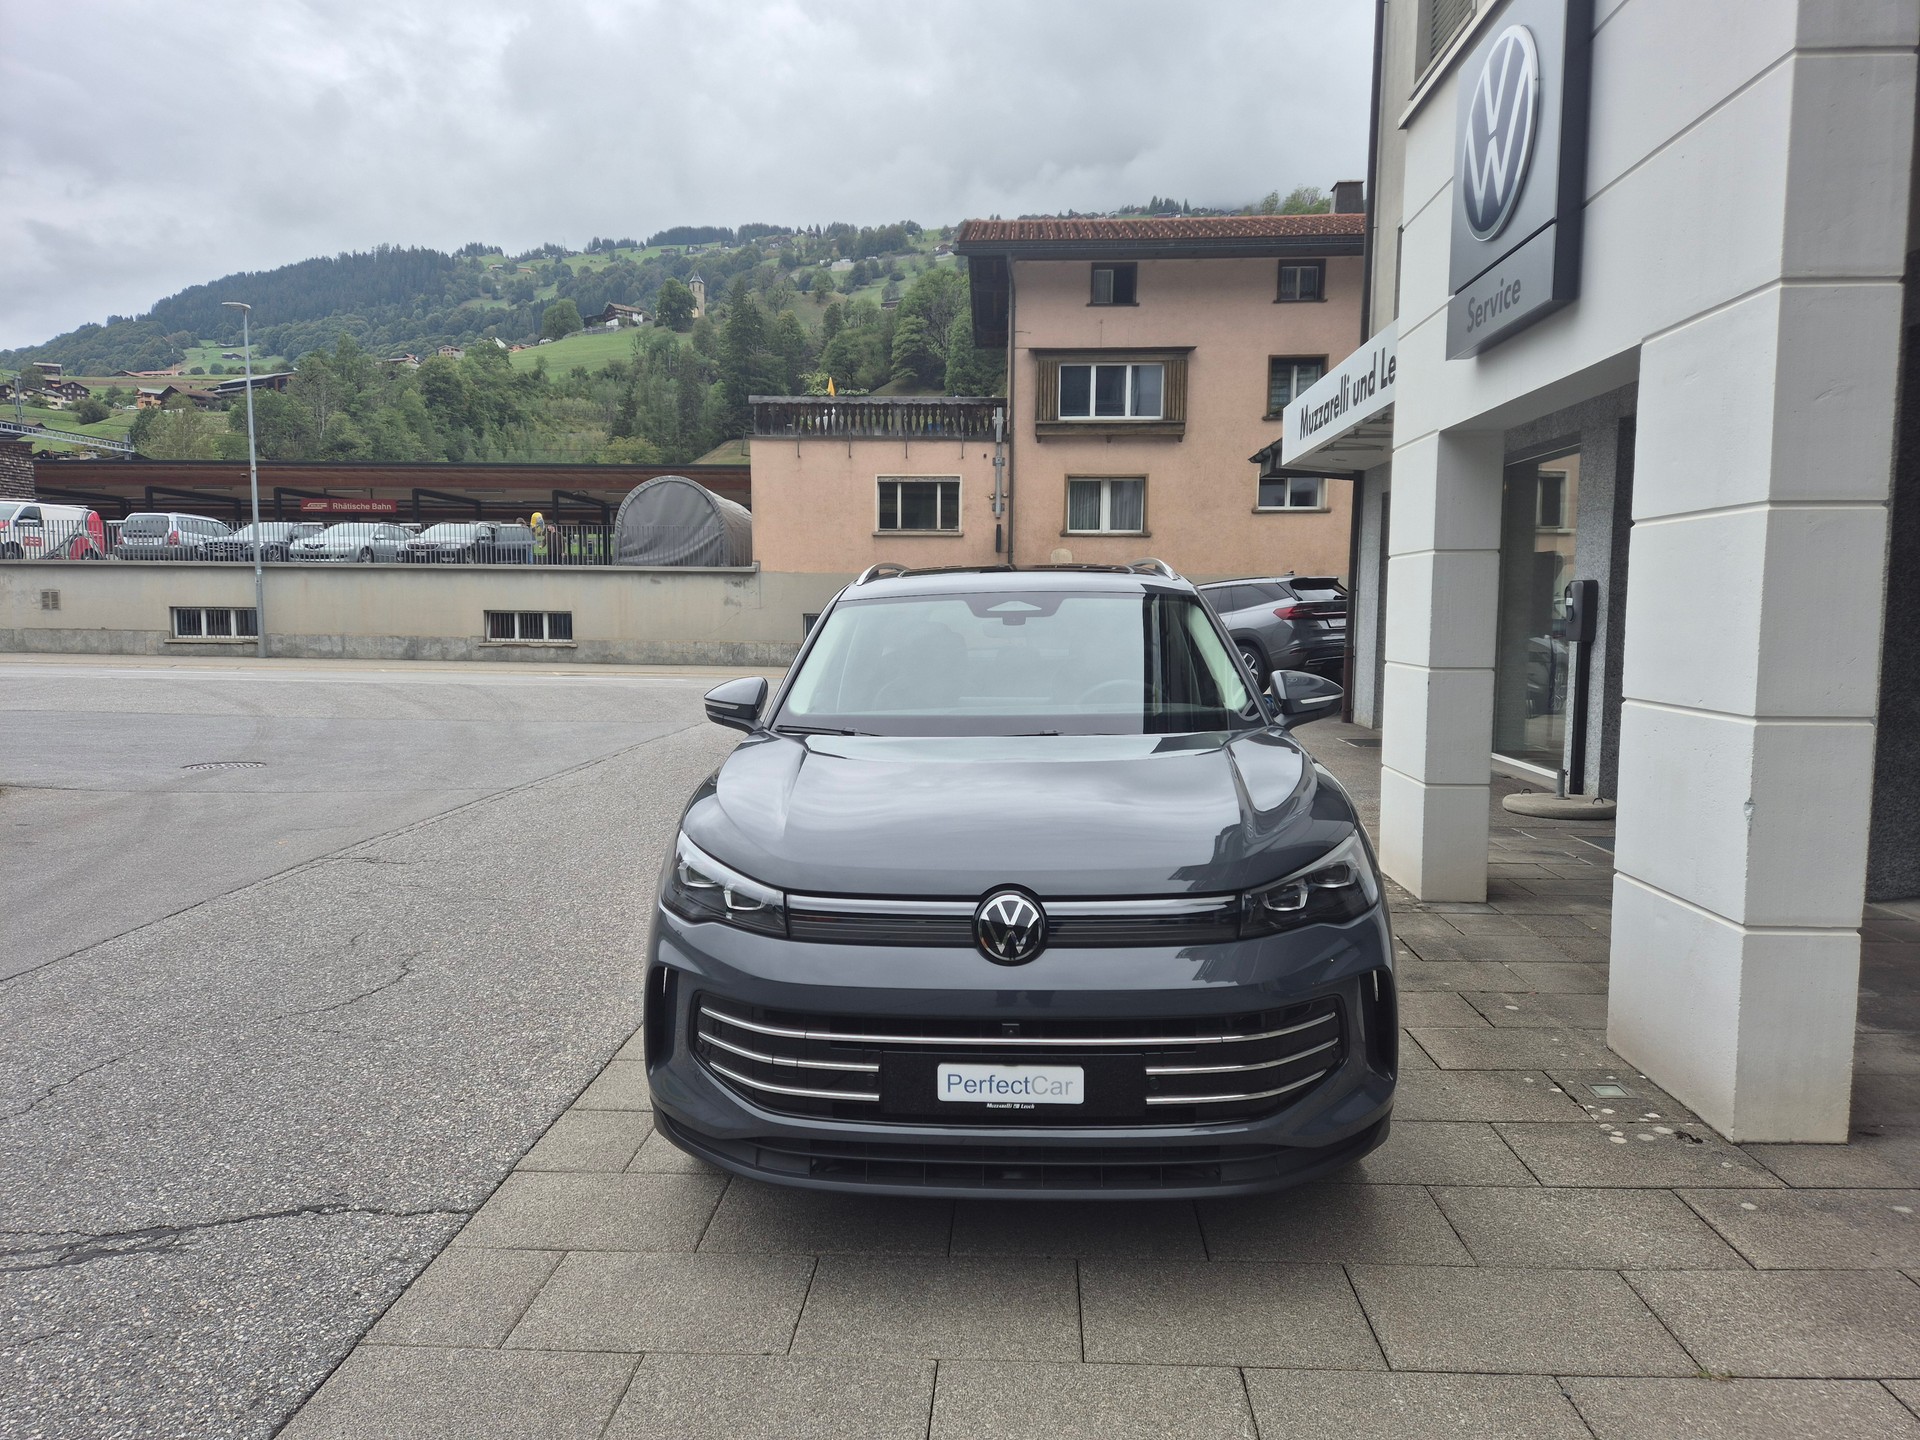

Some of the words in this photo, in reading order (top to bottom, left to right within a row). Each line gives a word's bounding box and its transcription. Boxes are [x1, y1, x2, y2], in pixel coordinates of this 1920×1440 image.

[1467, 278, 1520, 333] Service
[1299, 373, 1350, 440] Muzzarelli
[1353, 352, 1377, 406] und
[332, 502, 370, 510] Rhätische
[371, 502, 392, 510] Bahn
[947, 1074, 1073, 1096] PerfectCar
